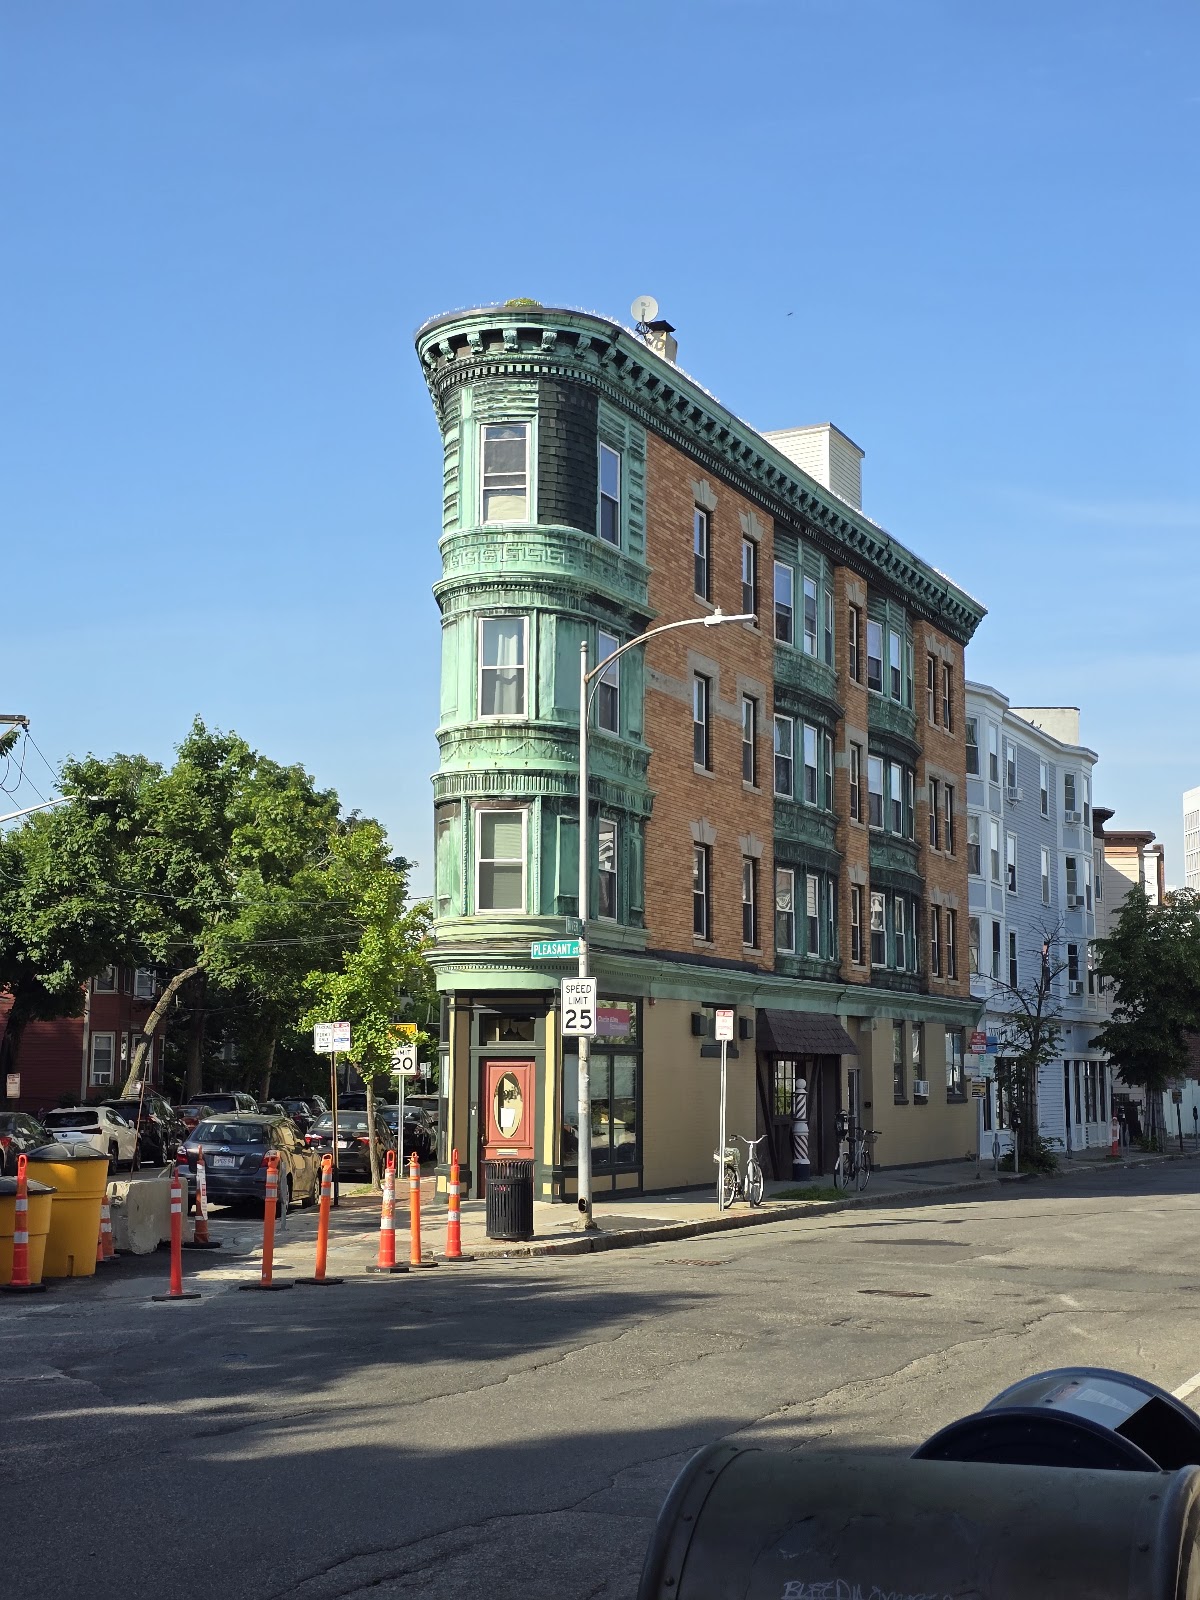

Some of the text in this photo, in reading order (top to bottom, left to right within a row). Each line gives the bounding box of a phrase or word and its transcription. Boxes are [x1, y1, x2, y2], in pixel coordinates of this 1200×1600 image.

[533, 943, 571, 955] PLEASANT
[566, 985, 592, 994] SPEED
[568, 996, 588, 1005] LIMIT
[565, 1009, 592, 1029] 25
[391, 1057, 413, 1070] 20
